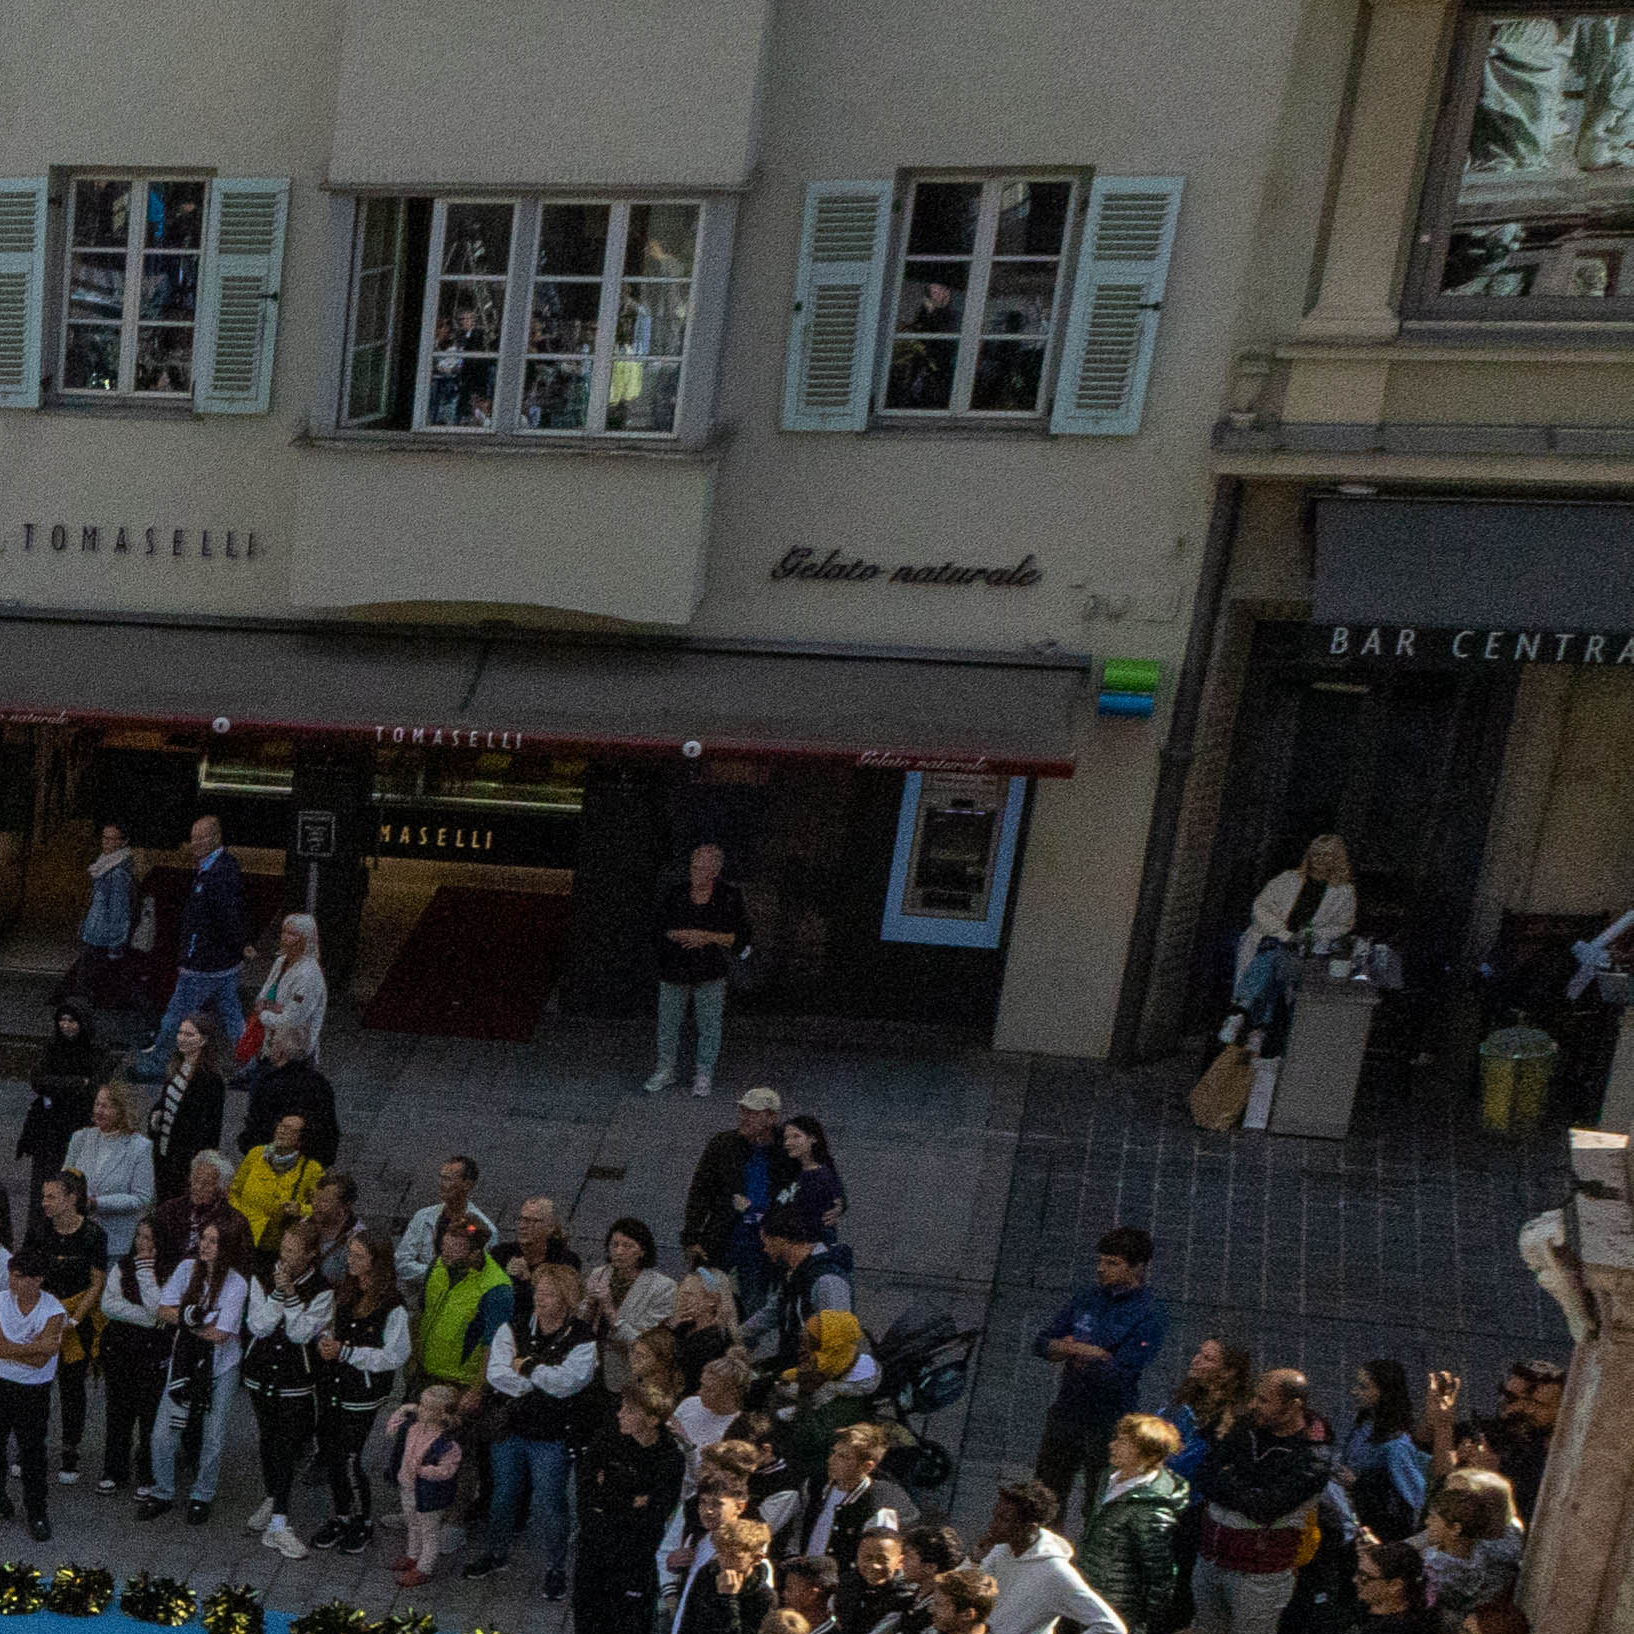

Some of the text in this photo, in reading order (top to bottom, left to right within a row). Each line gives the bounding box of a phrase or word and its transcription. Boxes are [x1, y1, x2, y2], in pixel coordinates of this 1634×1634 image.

[23, 523, 255, 560] TOMASELLI
[770, 545, 1044, 587] Gelato naturale
[1329, 626, 1634, 665] BAR CENTRA
[375, 725, 525, 750] TOMASELLI
